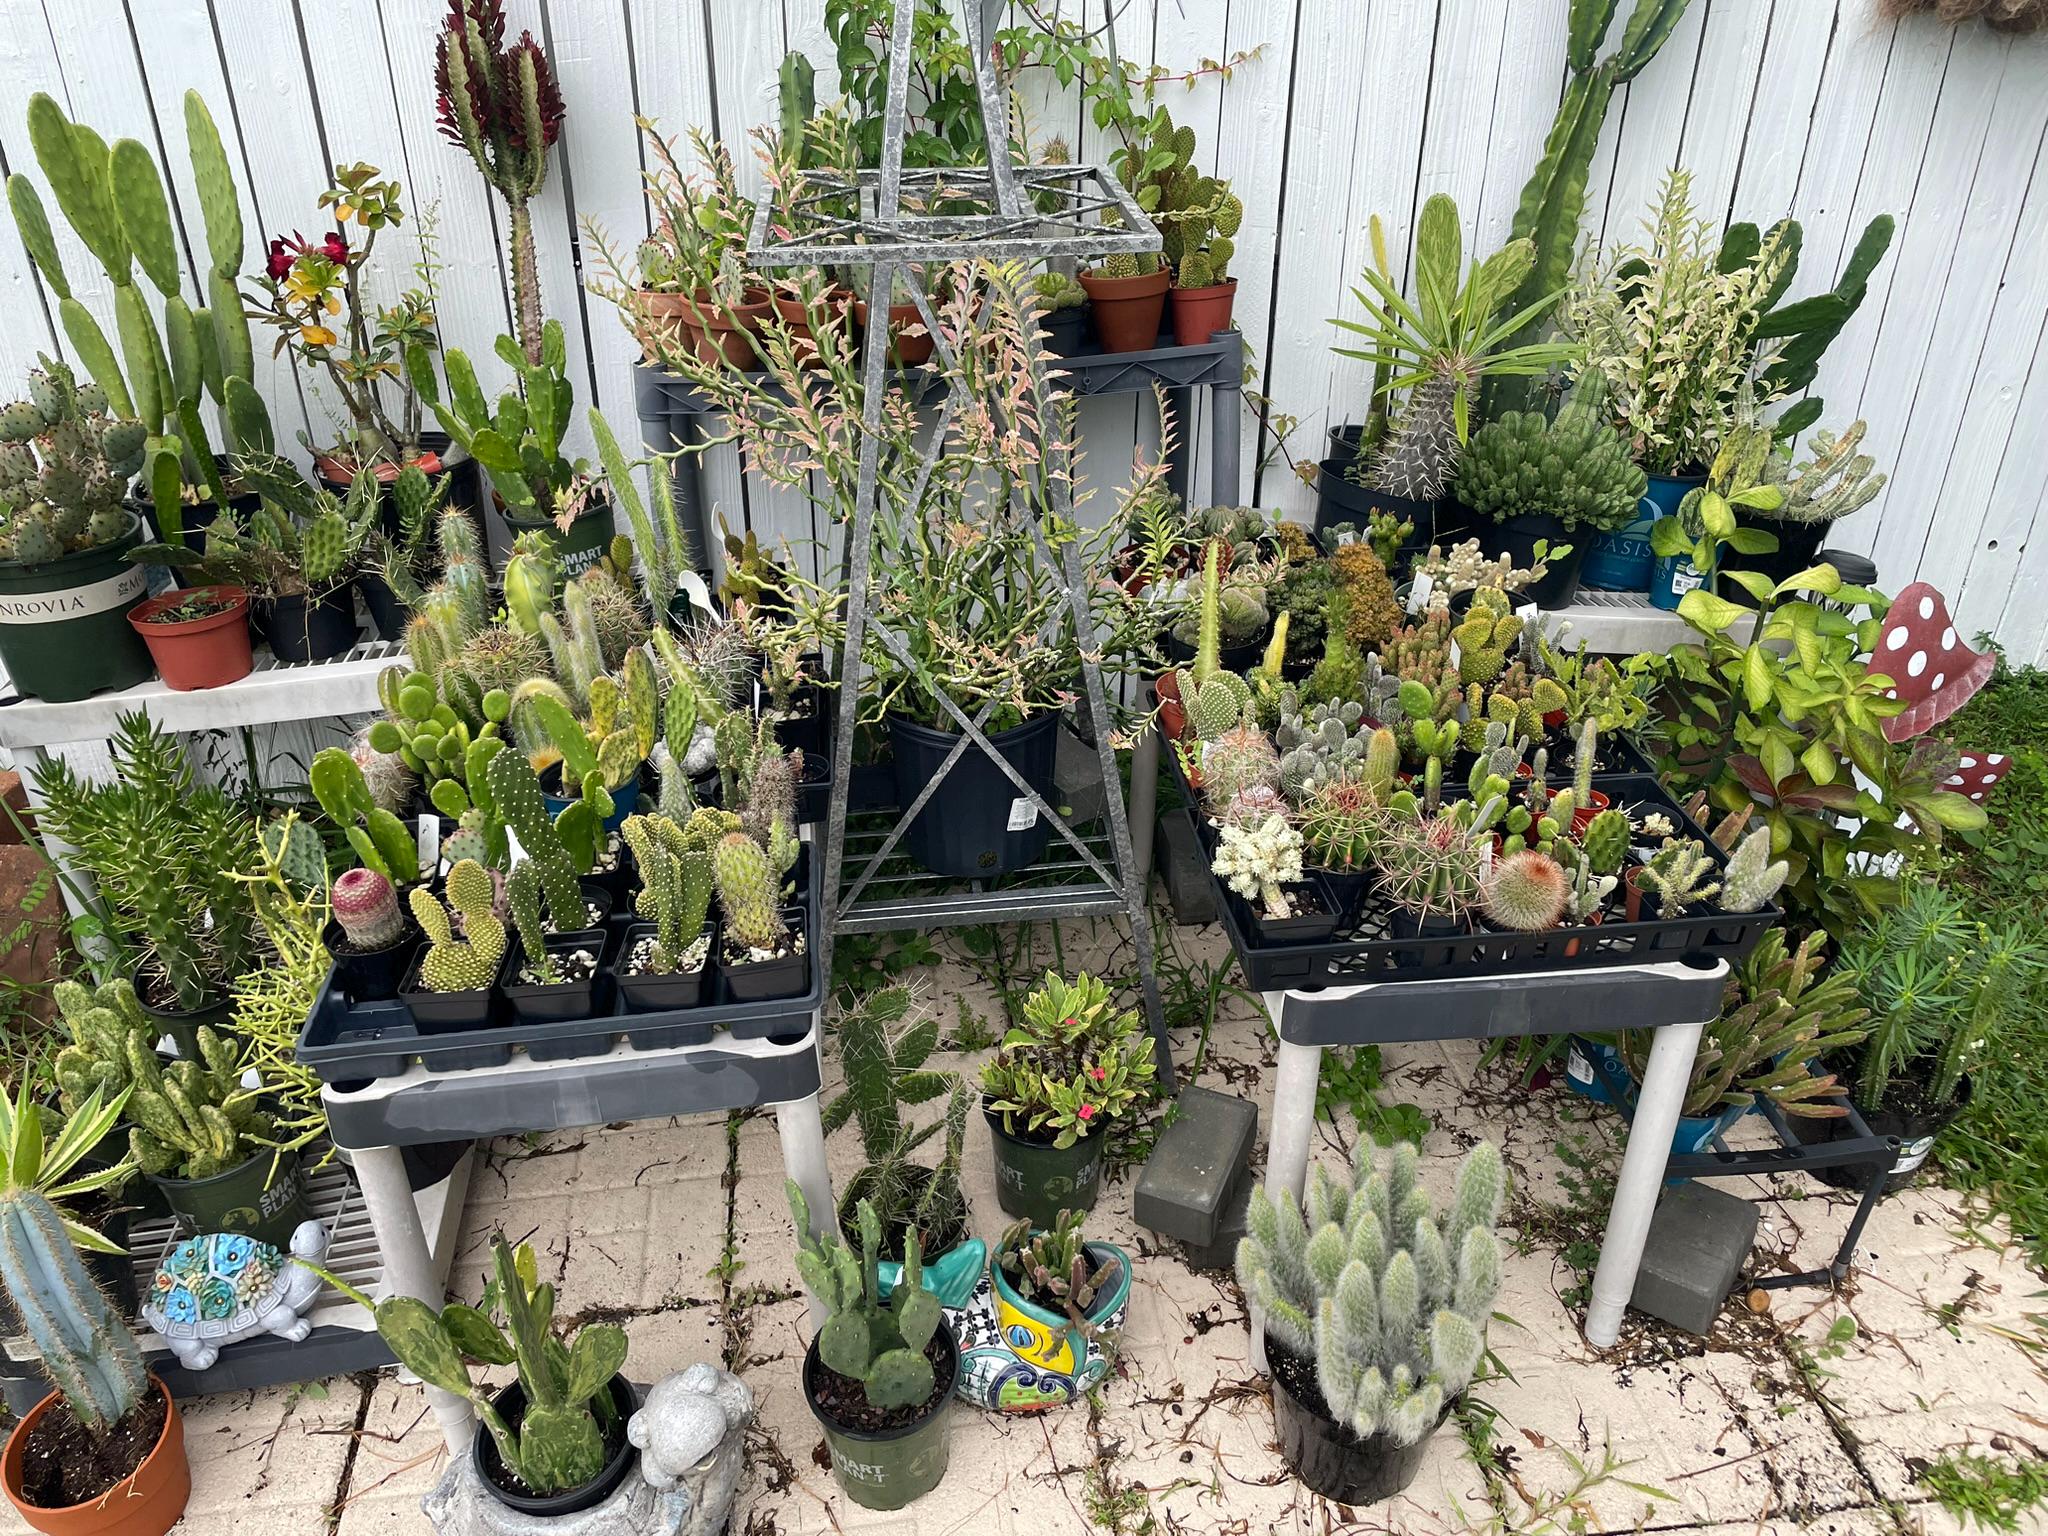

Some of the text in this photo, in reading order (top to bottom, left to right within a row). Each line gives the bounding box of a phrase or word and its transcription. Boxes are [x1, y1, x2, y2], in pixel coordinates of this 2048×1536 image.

[565, 560, 593, 576] LAN
[259, 1164, 299, 1208] SMAR
[262, 1183, 297, 1218] PLAN
